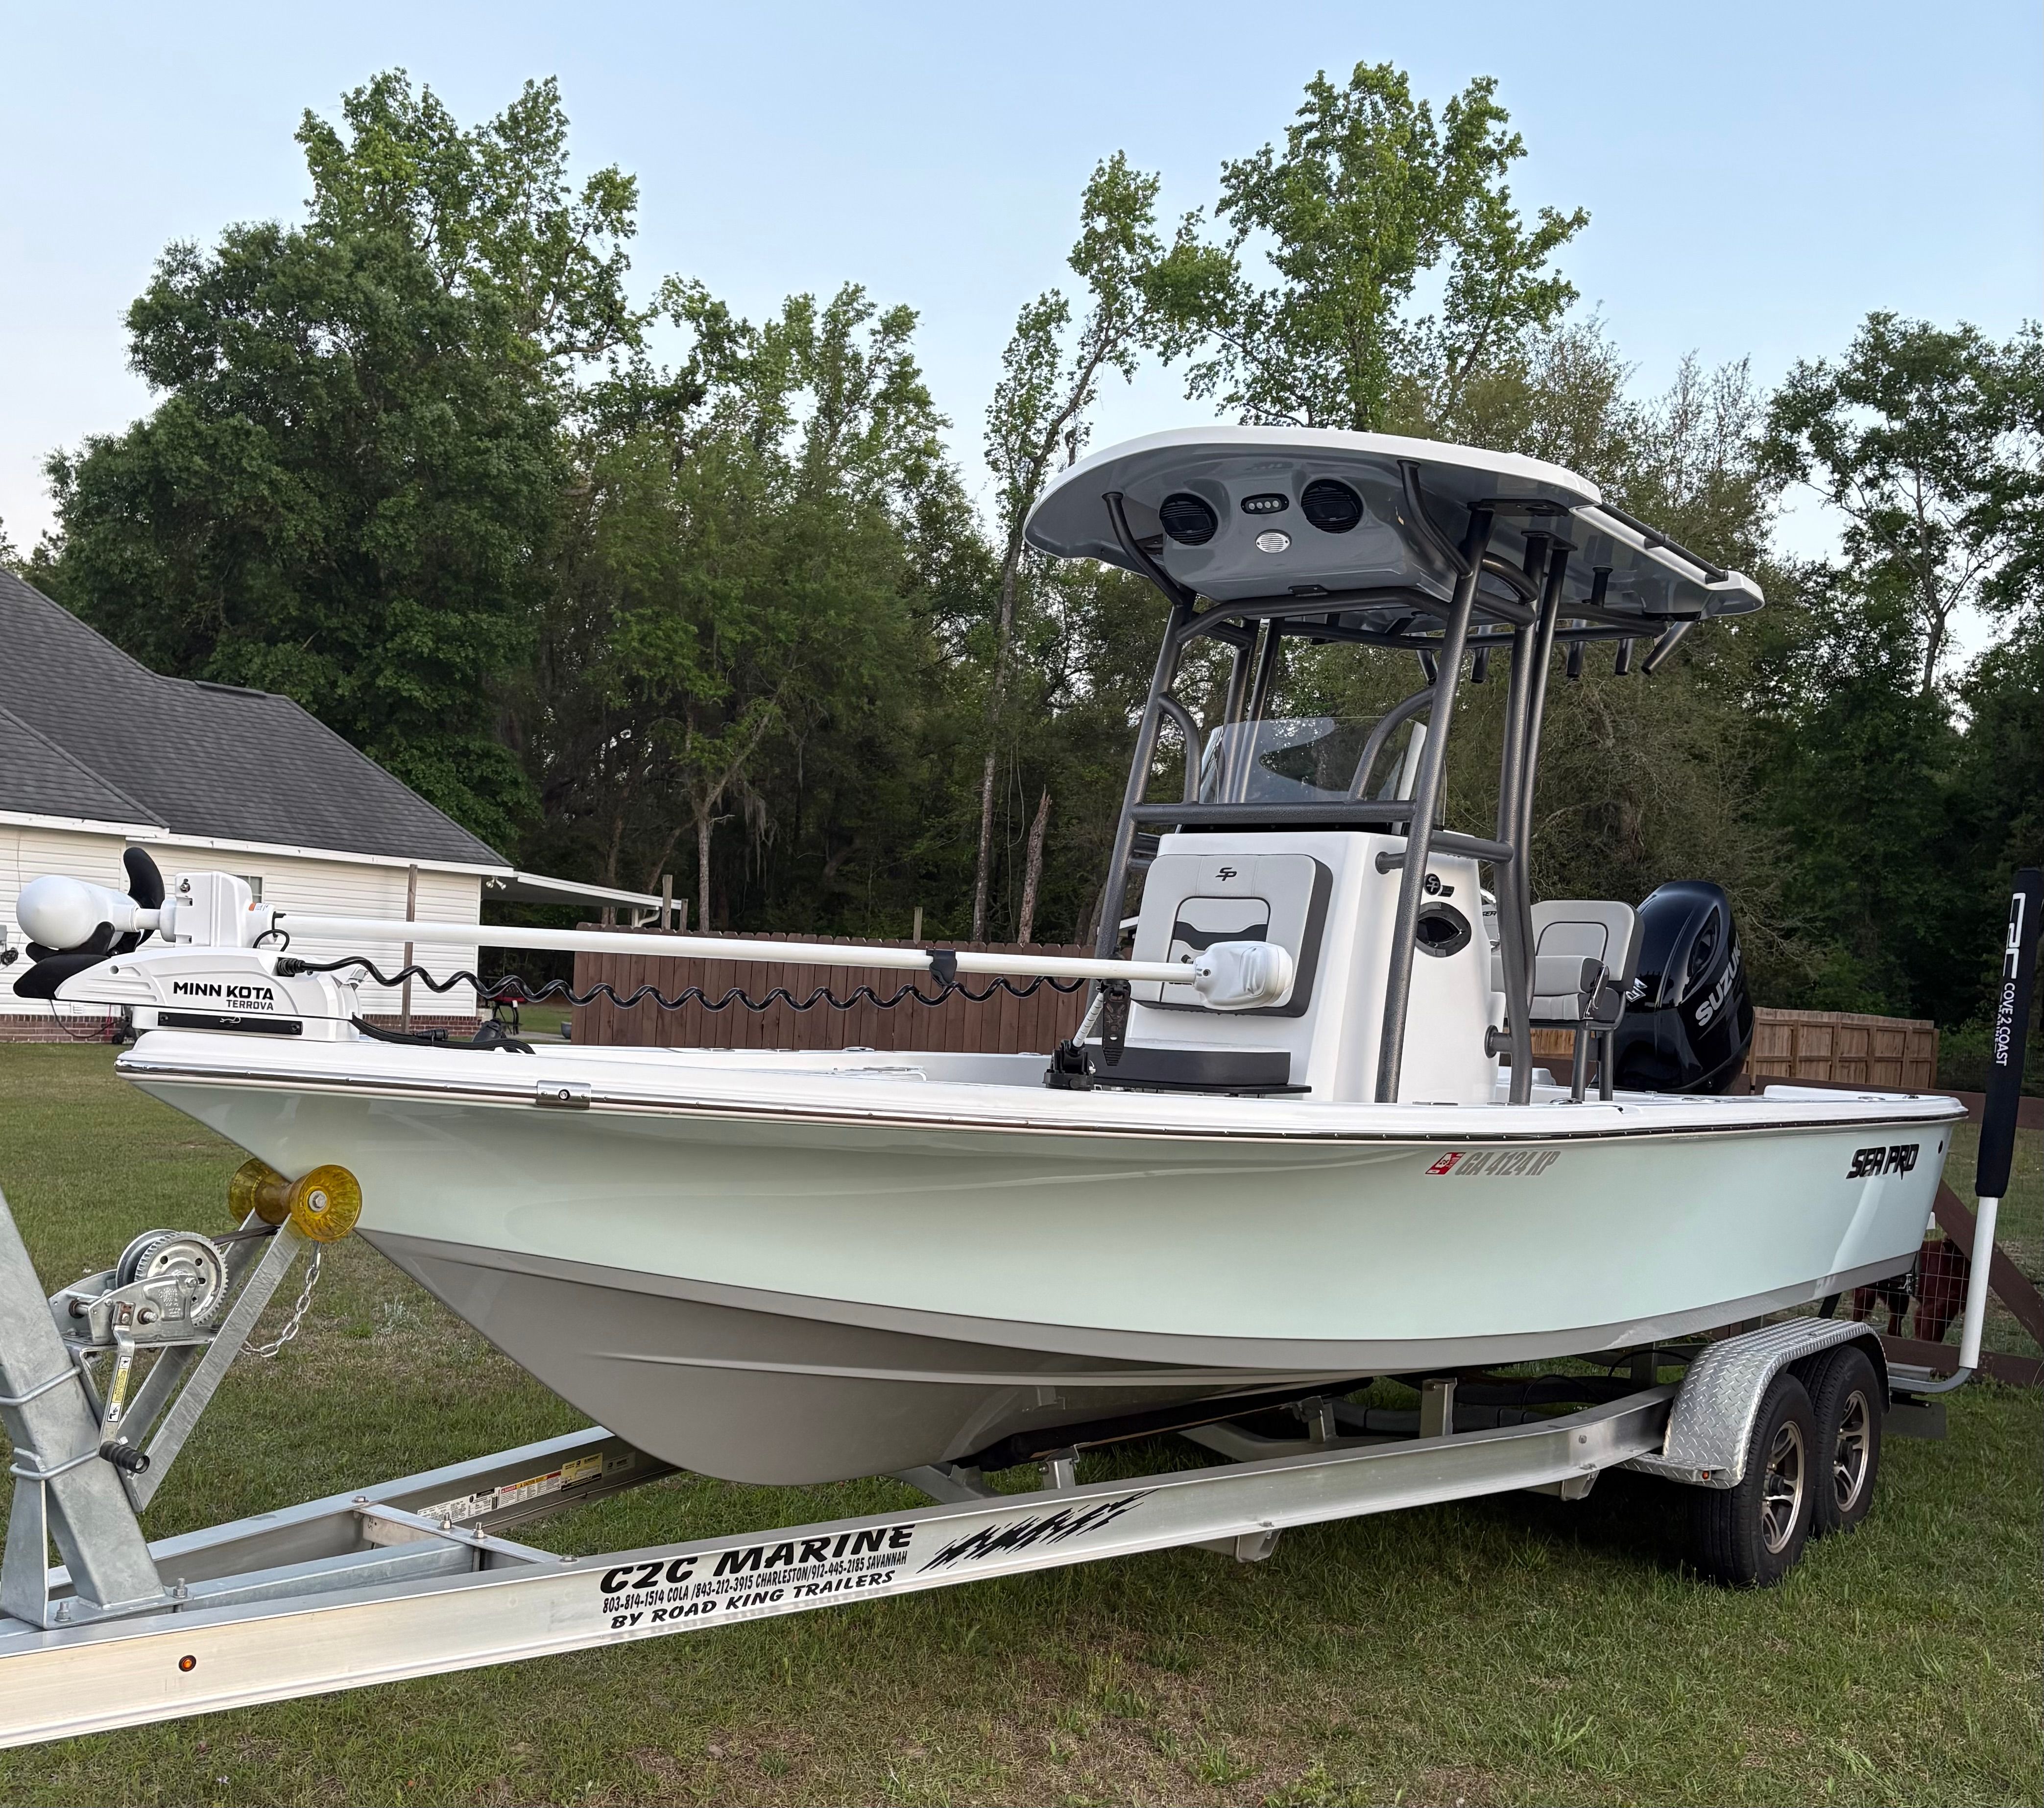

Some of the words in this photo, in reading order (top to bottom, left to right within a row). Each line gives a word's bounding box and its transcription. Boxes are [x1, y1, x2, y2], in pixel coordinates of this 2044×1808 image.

[173, 981, 221, 997] MINN
[227, 985, 274, 1001] KOTA
[226, 999, 274, 1011] TERROVA
[2001, 983, 2016, 1015] COVE
[1996, 1026, 2011, 1066] COAST
[1455, 1152, 1494, 1176] GA
[1484, 1151, 1539, 1176] 4124
[1845, 1146, 1887, 1180] SEA
[1882, 1143, 1920, 1180] PRO
[600, 1556, 698, 1593] C2C
[713, 1524, 916, 1577] MARINE
[602, 1590, 665, 1614] 803-814-1514
[667, 1585, 688, 1603] COLA
[691, 1575, 754, 1601] /843-212-3915
[756, 1557, 865, 1588] CHARLESTON/912-445-2185
[866, 1550, 908, 1570] SAVANNAH
[610, 1612, 644, 1629] BY
[650, 1600, 717, 1623] ROAD
[725, 1589, 784, 1610] KING
[793, 1570, 895, 1599] TRAILERS
